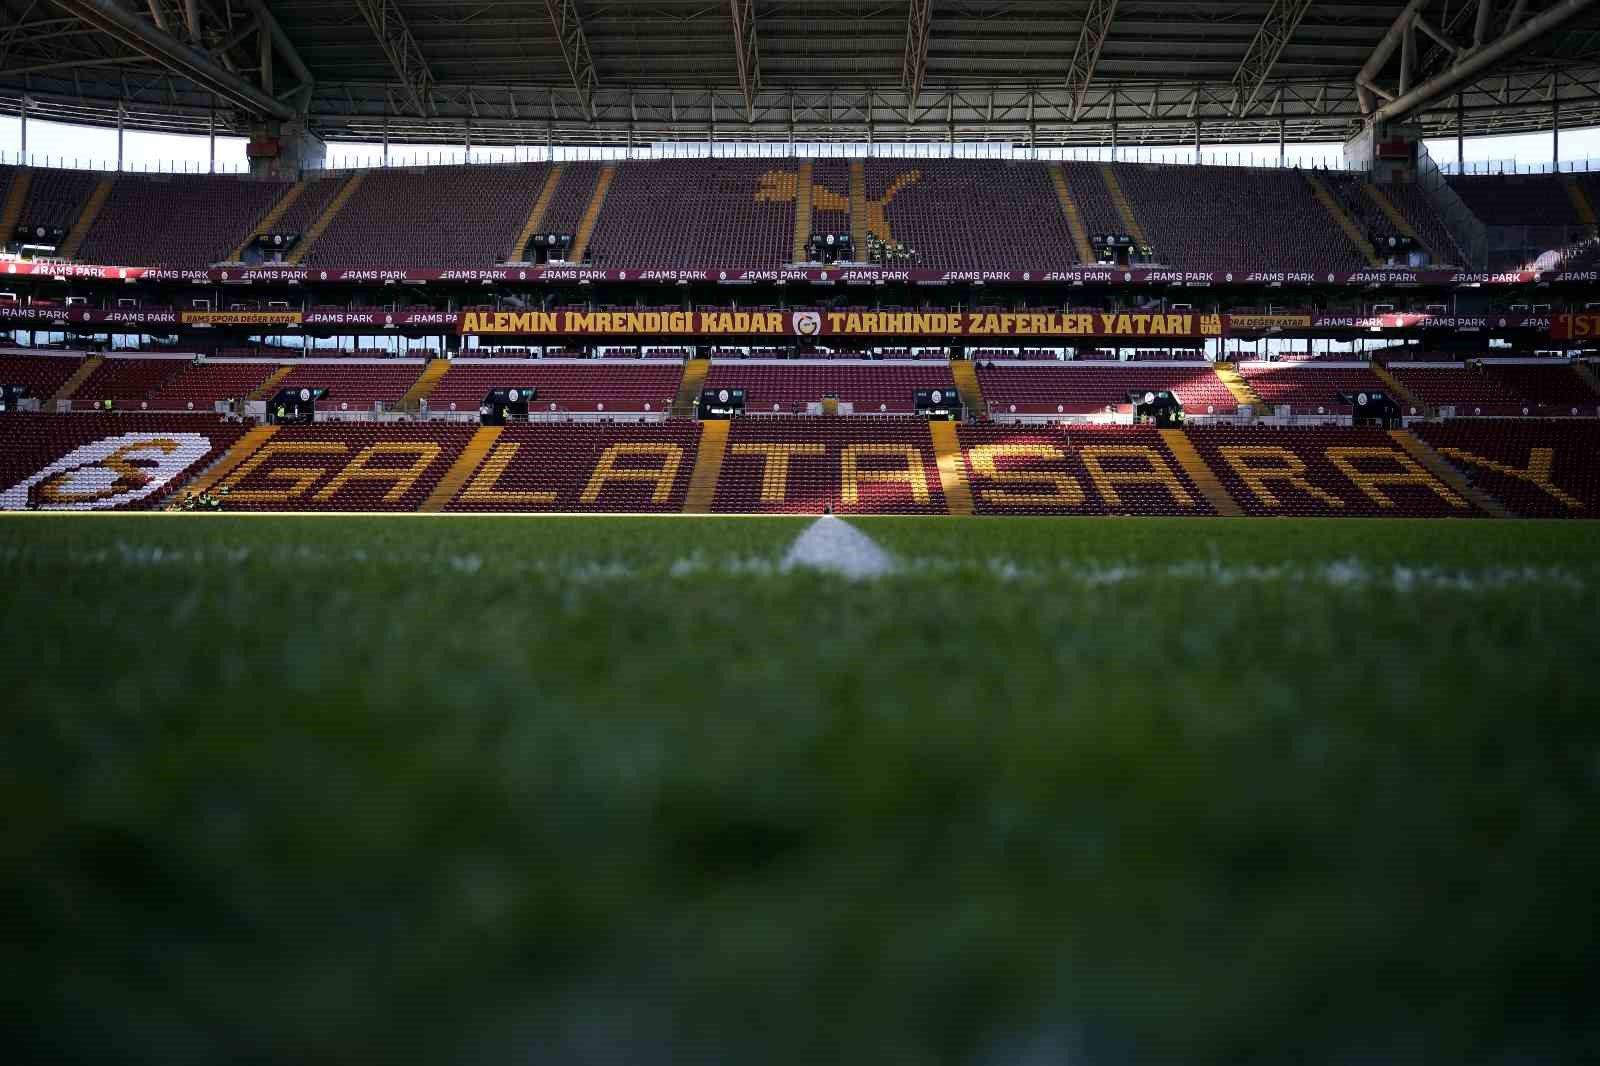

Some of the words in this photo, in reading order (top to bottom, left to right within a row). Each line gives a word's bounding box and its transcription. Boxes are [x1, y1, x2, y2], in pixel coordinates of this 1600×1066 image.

[40, 265, 73, 276] RAMS
[76, 267, 105, 277] PARK
[149, 270, 178, 279] RAMS
[181, 271, 208, 279] PARK
[250, 271, 279, 279] RAMS
[281, 271, 307, 279] PARK
[349, 271, 377, 279] RAMS
[380, 271, 407, 279] PARK
[448, 271, 476, 279] RAMS
[480, 271, 507, 279] PARK
[548, 271, 577, 279] RAMS
[580, 271, 606, 279] PARK
[648, 271, 676, 279] RAMS
[679, 271, 707, 279] PARK
[748, 271, 777, 279] RAMS
[780, 271, 808, 279] PARK
[951, 272, 980, 280] RAMS
[983, 272, 1010, 280] PARK
[1052, 272, 1081, 280] RAMS
[1084, 272, 1111, 280] PARK
[1153, 272, 1182, 280] RAMS
[1186, 272, 1213, 280] PARK
[1255, 273, 1284, 281] RAMS
[1287, 273, 1315, 281] PARK
[1357, 273, 1386, 281] RAMS
[1389, 273, 1417, 281] PARK
[1458, 273, 1488, 282] RAMS
[1492, 273, 1520, 282] PARK
[1565, 272, 1596, 280] RAMS
[2, 309, 34, 317] RAMS
[39, 310, 69, 319] PARK
[114, 313, 145, 321] RAMS
[148, 314, 175, 322] PARK
[314, 314, 343, 322] RAMS
[346, 314, 373, 322] PARK
[415, 315, 443, 323] RAMS
[701, 312, 783, 333] KADAR
[1323, 318, 1353, 326] RAMS
[1356, 318, 1384, 326] PARK
[1425, 319, 1455, 327] RAMS
[1458, 319, 1487, 327] PARK
[969, 313, 1094, 334] ZAFERLER
[1100, 314, 1192, 334] YATAR!
[216, 441, 1583, 509] GALATASARAY
